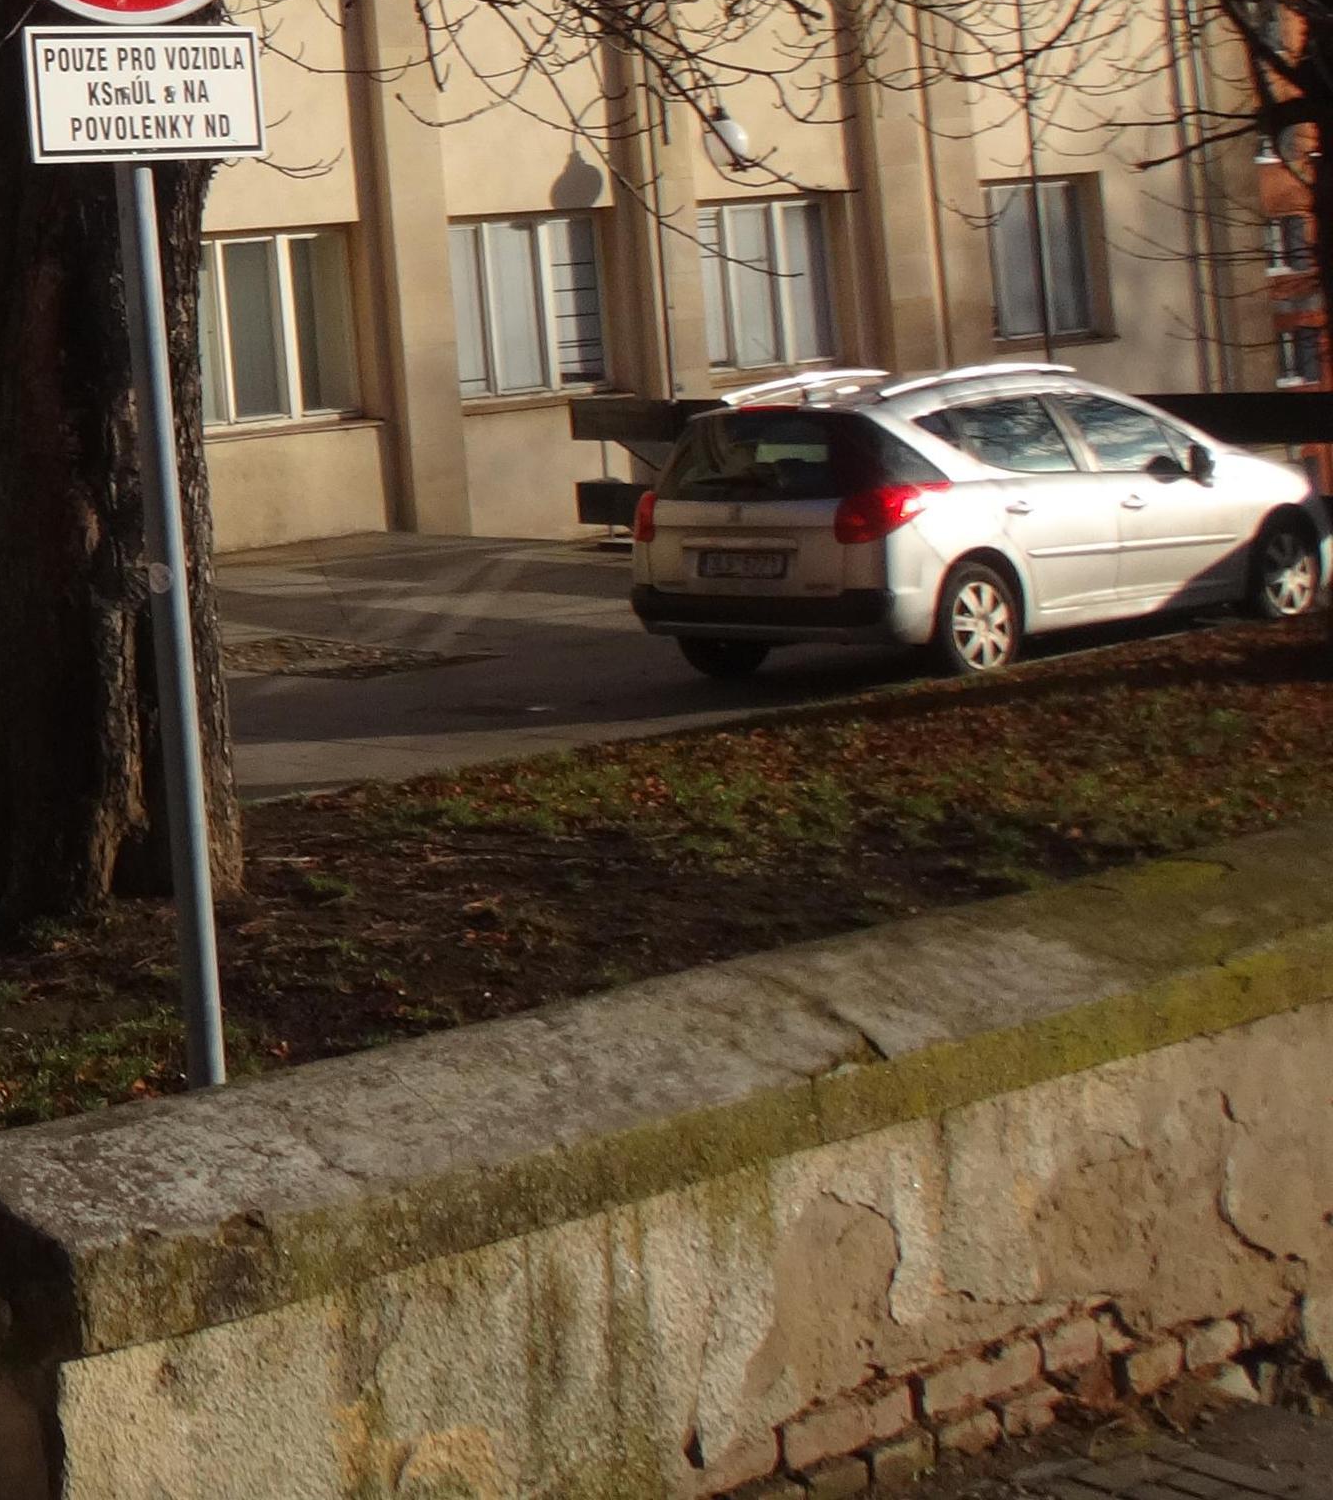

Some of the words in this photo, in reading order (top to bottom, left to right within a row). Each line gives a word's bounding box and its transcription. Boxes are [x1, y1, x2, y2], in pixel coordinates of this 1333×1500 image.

[44, 47, 108, 72] POUZE
[117, 46, 156, 71] PRO
[164, 46, 245, 70] VOZIDLA
[183, 80, 210, 103] NA
[71, 114, 194, 141] POVOLENKY
[205, 114, 231, 138] ND
